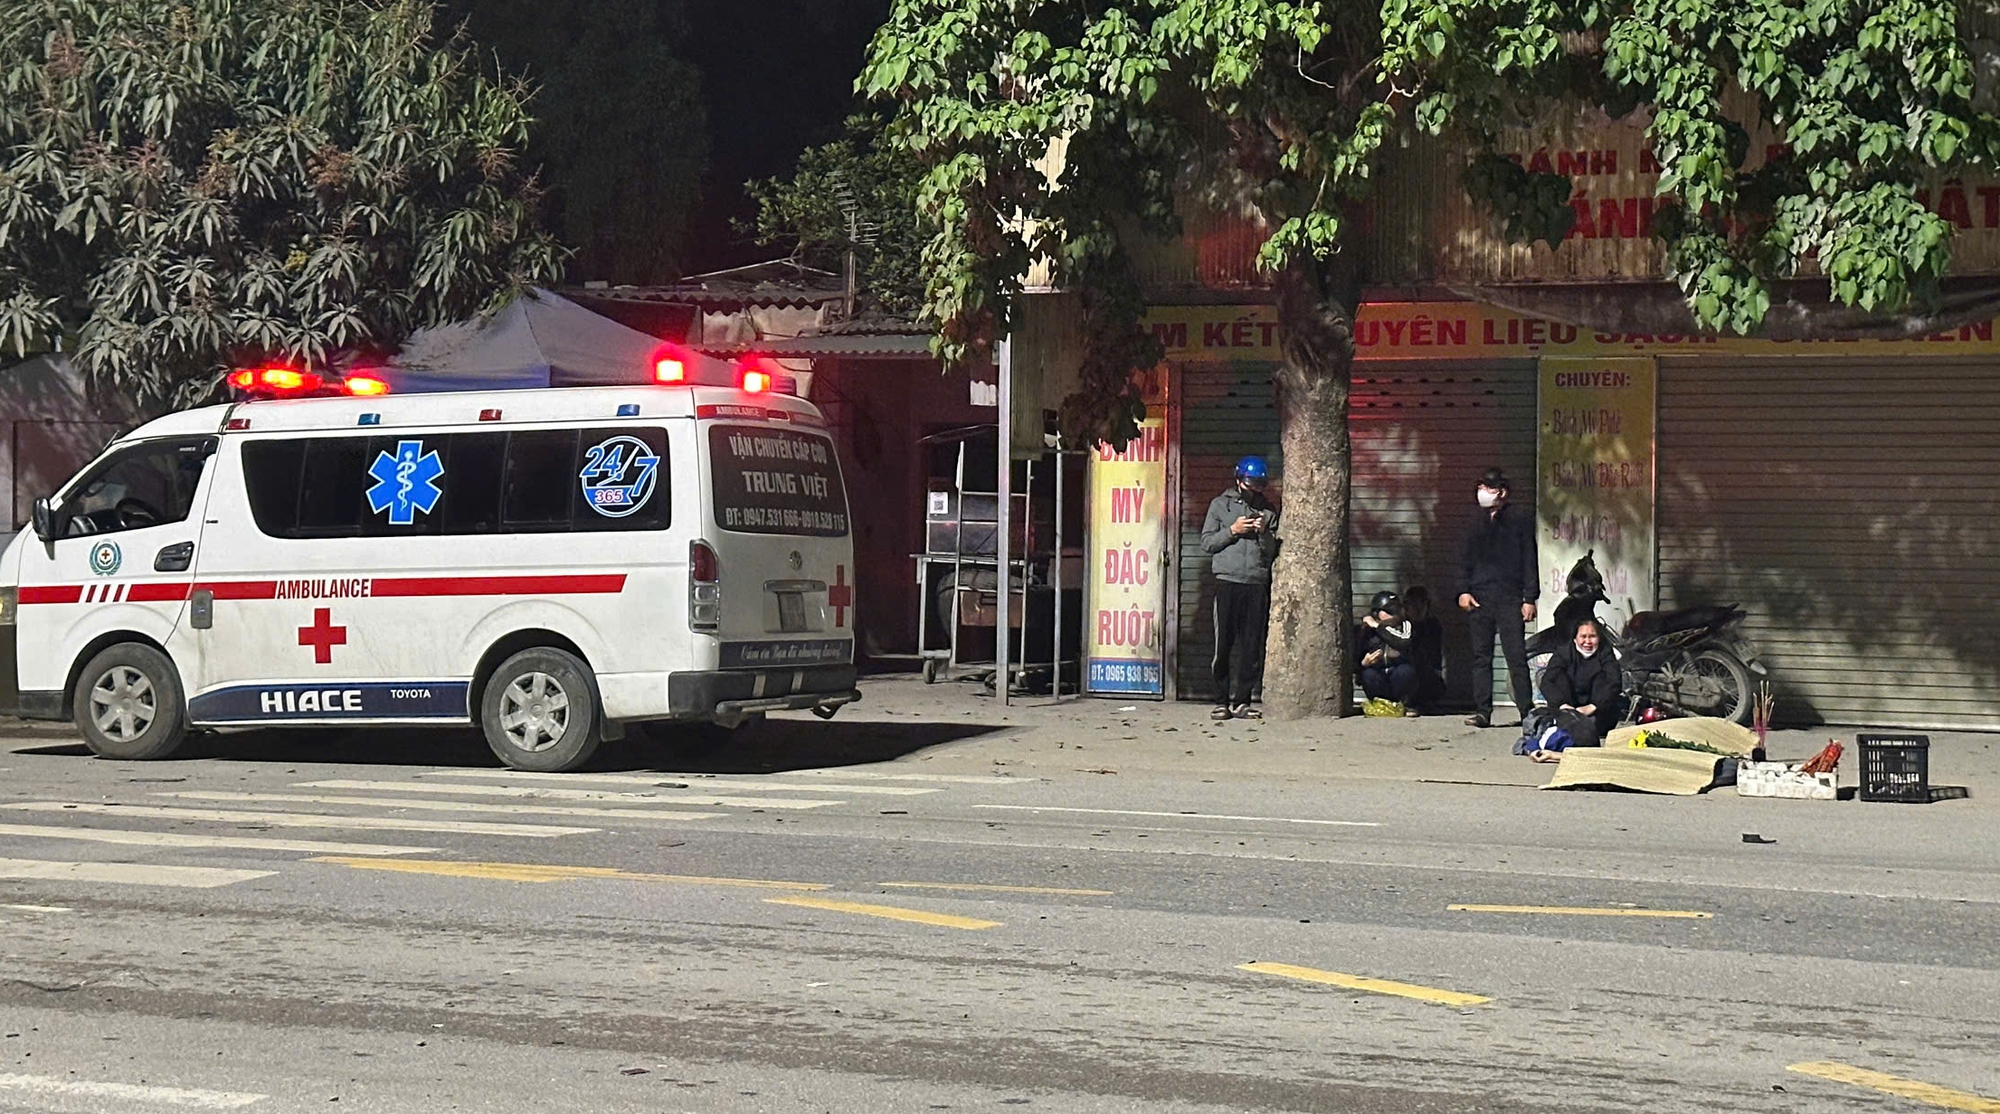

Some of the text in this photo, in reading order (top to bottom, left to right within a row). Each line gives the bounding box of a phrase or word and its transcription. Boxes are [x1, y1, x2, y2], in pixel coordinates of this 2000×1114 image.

[1203, 313, 1278, 347] KẾT
[1353, 315, 1466, 347] UYÊN
[1555, 370, 1630, 387] CHUYÊN:
[729, 432, 753, 460] VẬN
[1100, 427, 1159, 462] BNH
[595, 489, 623, 503] 365
[742, 471, 828, 499] TRUNG VIỆT
[1112, 480, 1145, 523] MỲ
[1105, 541, 1149, 593] ĐẶC
[277, 579, 370, 600] AMBULANCE
[1098, 602, 1155, 655] RUỘT
[1106, 665, 1125, 683] 0965
[1126, 666, 1142, 683] 938
[260, 689, 432, 713] HIACE TOYOTA
